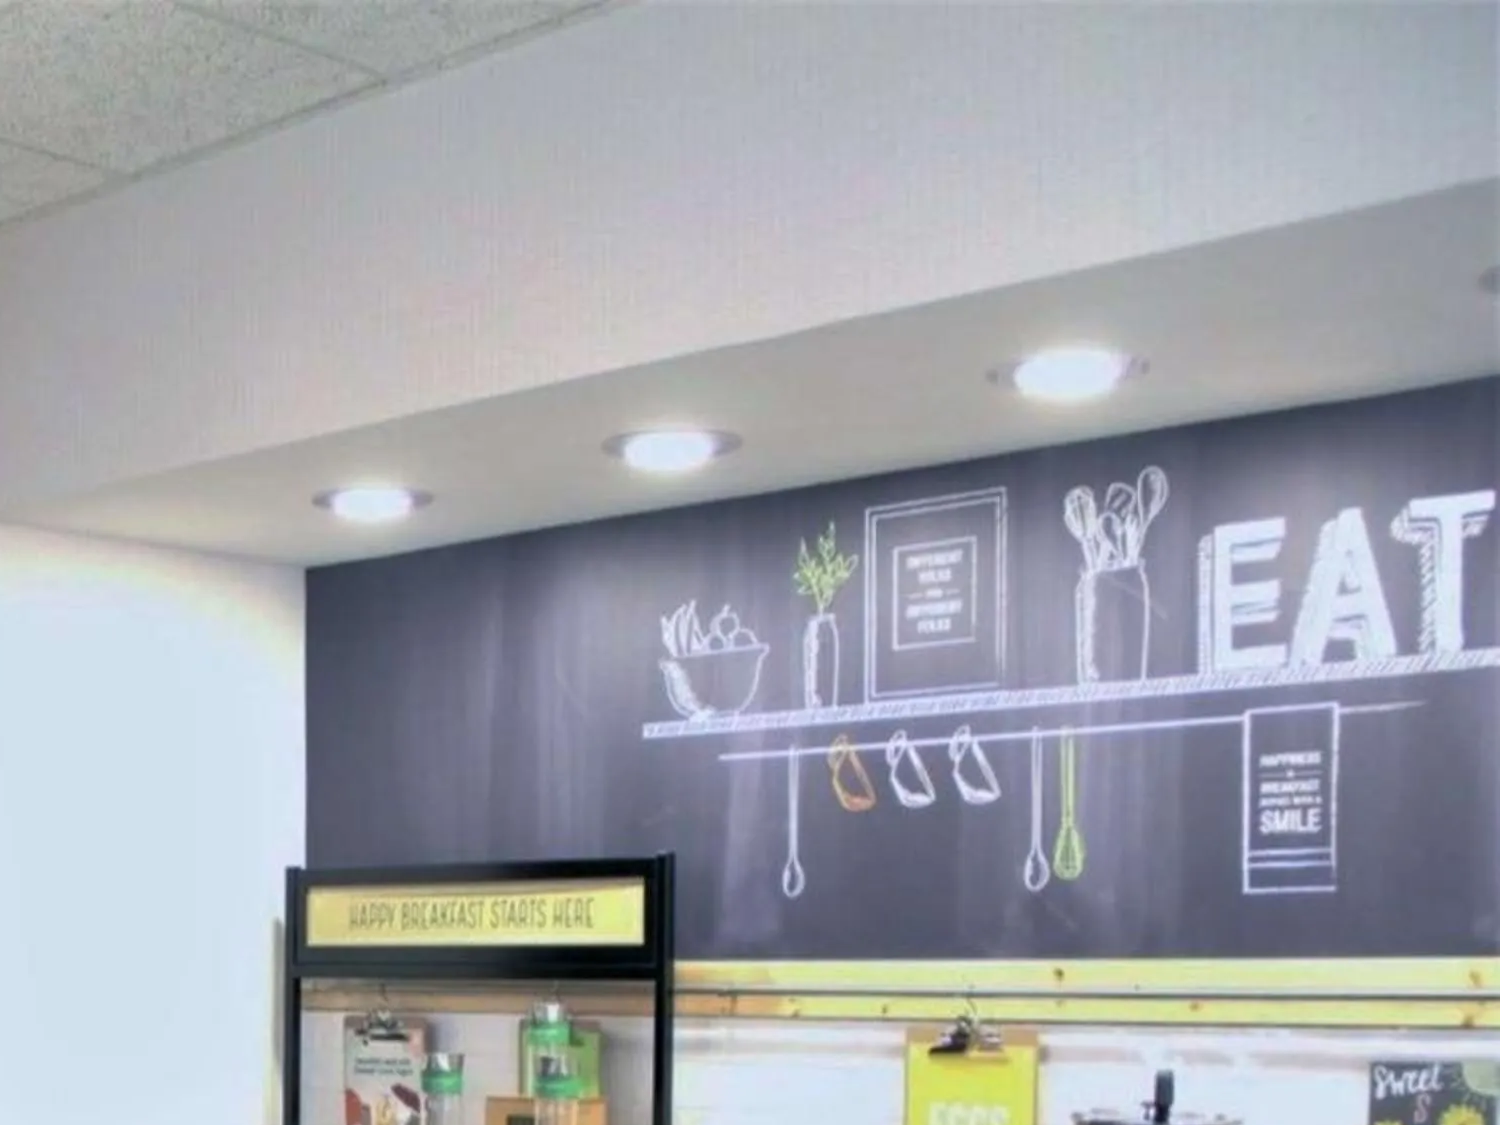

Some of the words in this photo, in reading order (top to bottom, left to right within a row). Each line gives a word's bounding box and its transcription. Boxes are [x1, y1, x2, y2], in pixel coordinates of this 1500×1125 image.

[1198, 489, 1496, 674] EAT
[1259, 808, 1322, 834] SMILE
[350, 902, 396, 932] HAPPY
[400, 901, 484, 930] BREAKFAST
[489, 899, 547, 929] STARTS
[552, 897, 595, 929] HERE
